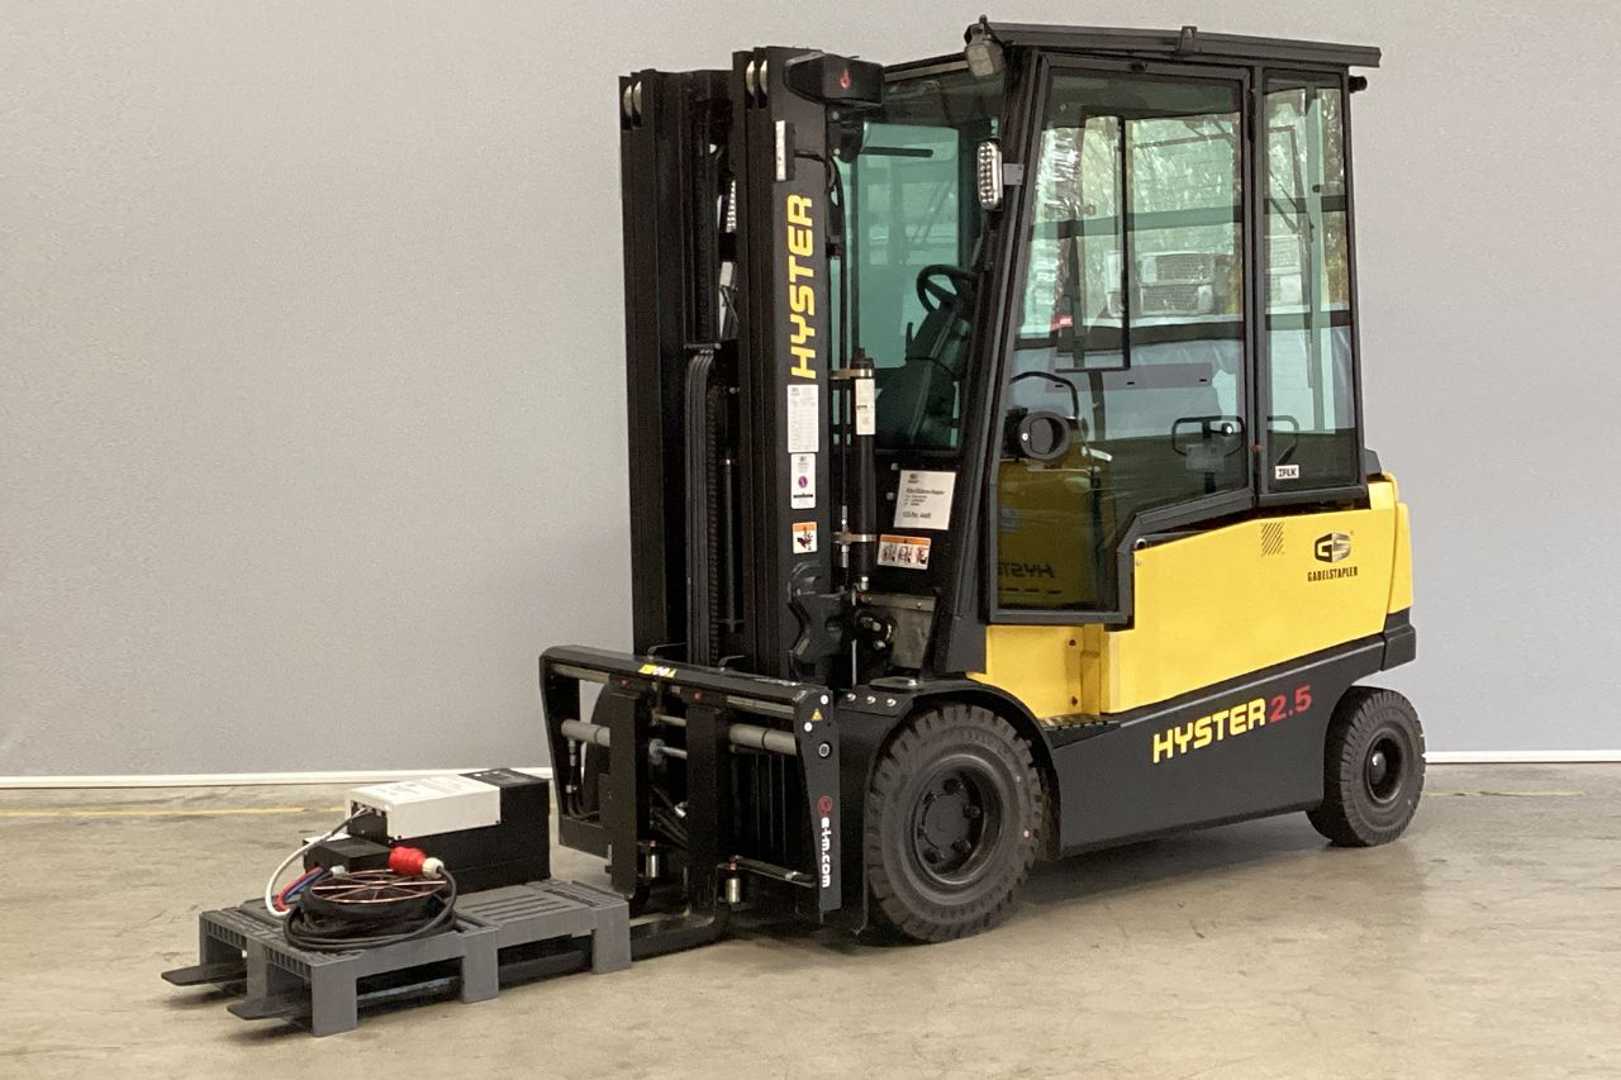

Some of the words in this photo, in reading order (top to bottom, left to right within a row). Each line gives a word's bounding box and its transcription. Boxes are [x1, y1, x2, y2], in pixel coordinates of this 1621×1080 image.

[787, 194, 816, 379] HYSTER
[1307, 566, 1359, 582] GABELSTAPLER
[1152, 698, 1266, 764] HYSTER
[1269, 684, 1312, 723] 2.5
